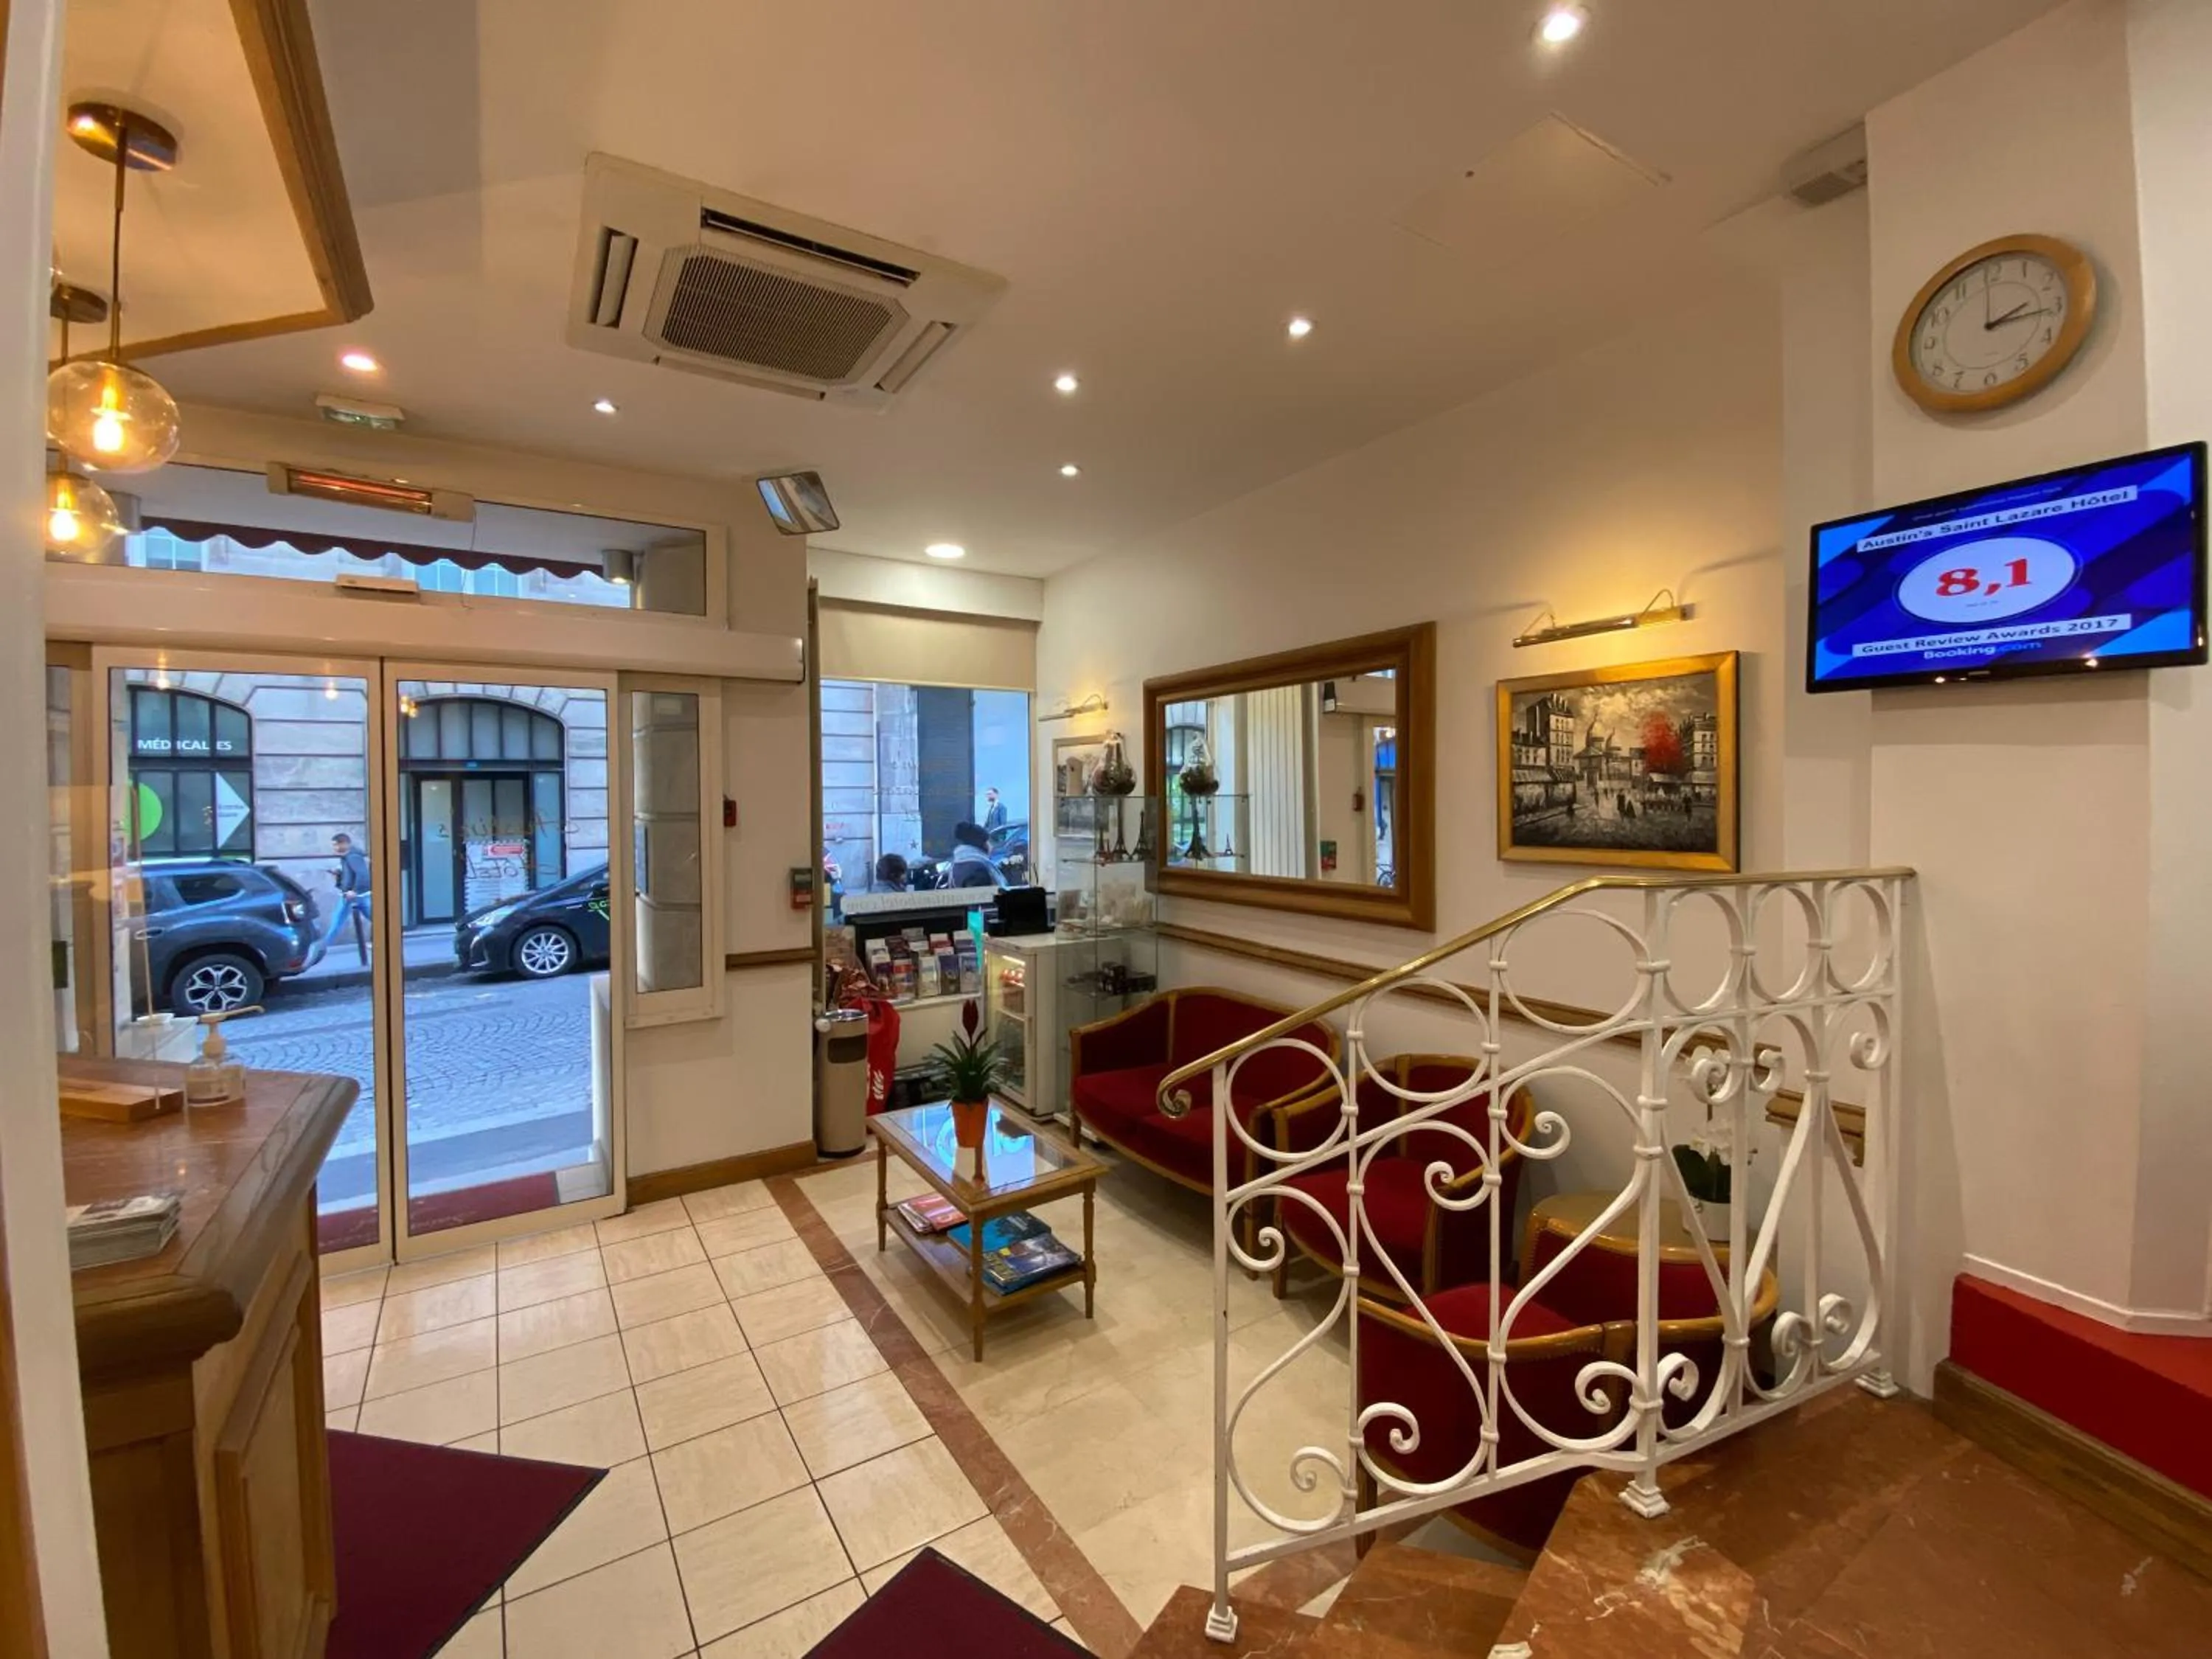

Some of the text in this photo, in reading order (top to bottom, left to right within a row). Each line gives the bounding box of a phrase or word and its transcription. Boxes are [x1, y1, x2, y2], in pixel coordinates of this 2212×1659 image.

[1862, 527, 1933, 550] Austin's
[1939, 517, 1989, 536] Saint
[1995, 503, 2064, 524] Lazare
[2070, 489, 2130, 510] Hôtel
[1936, 558, 2031, 597] 8,1
[1862, 618, 2118, 654] Guest Review Awards 2017
